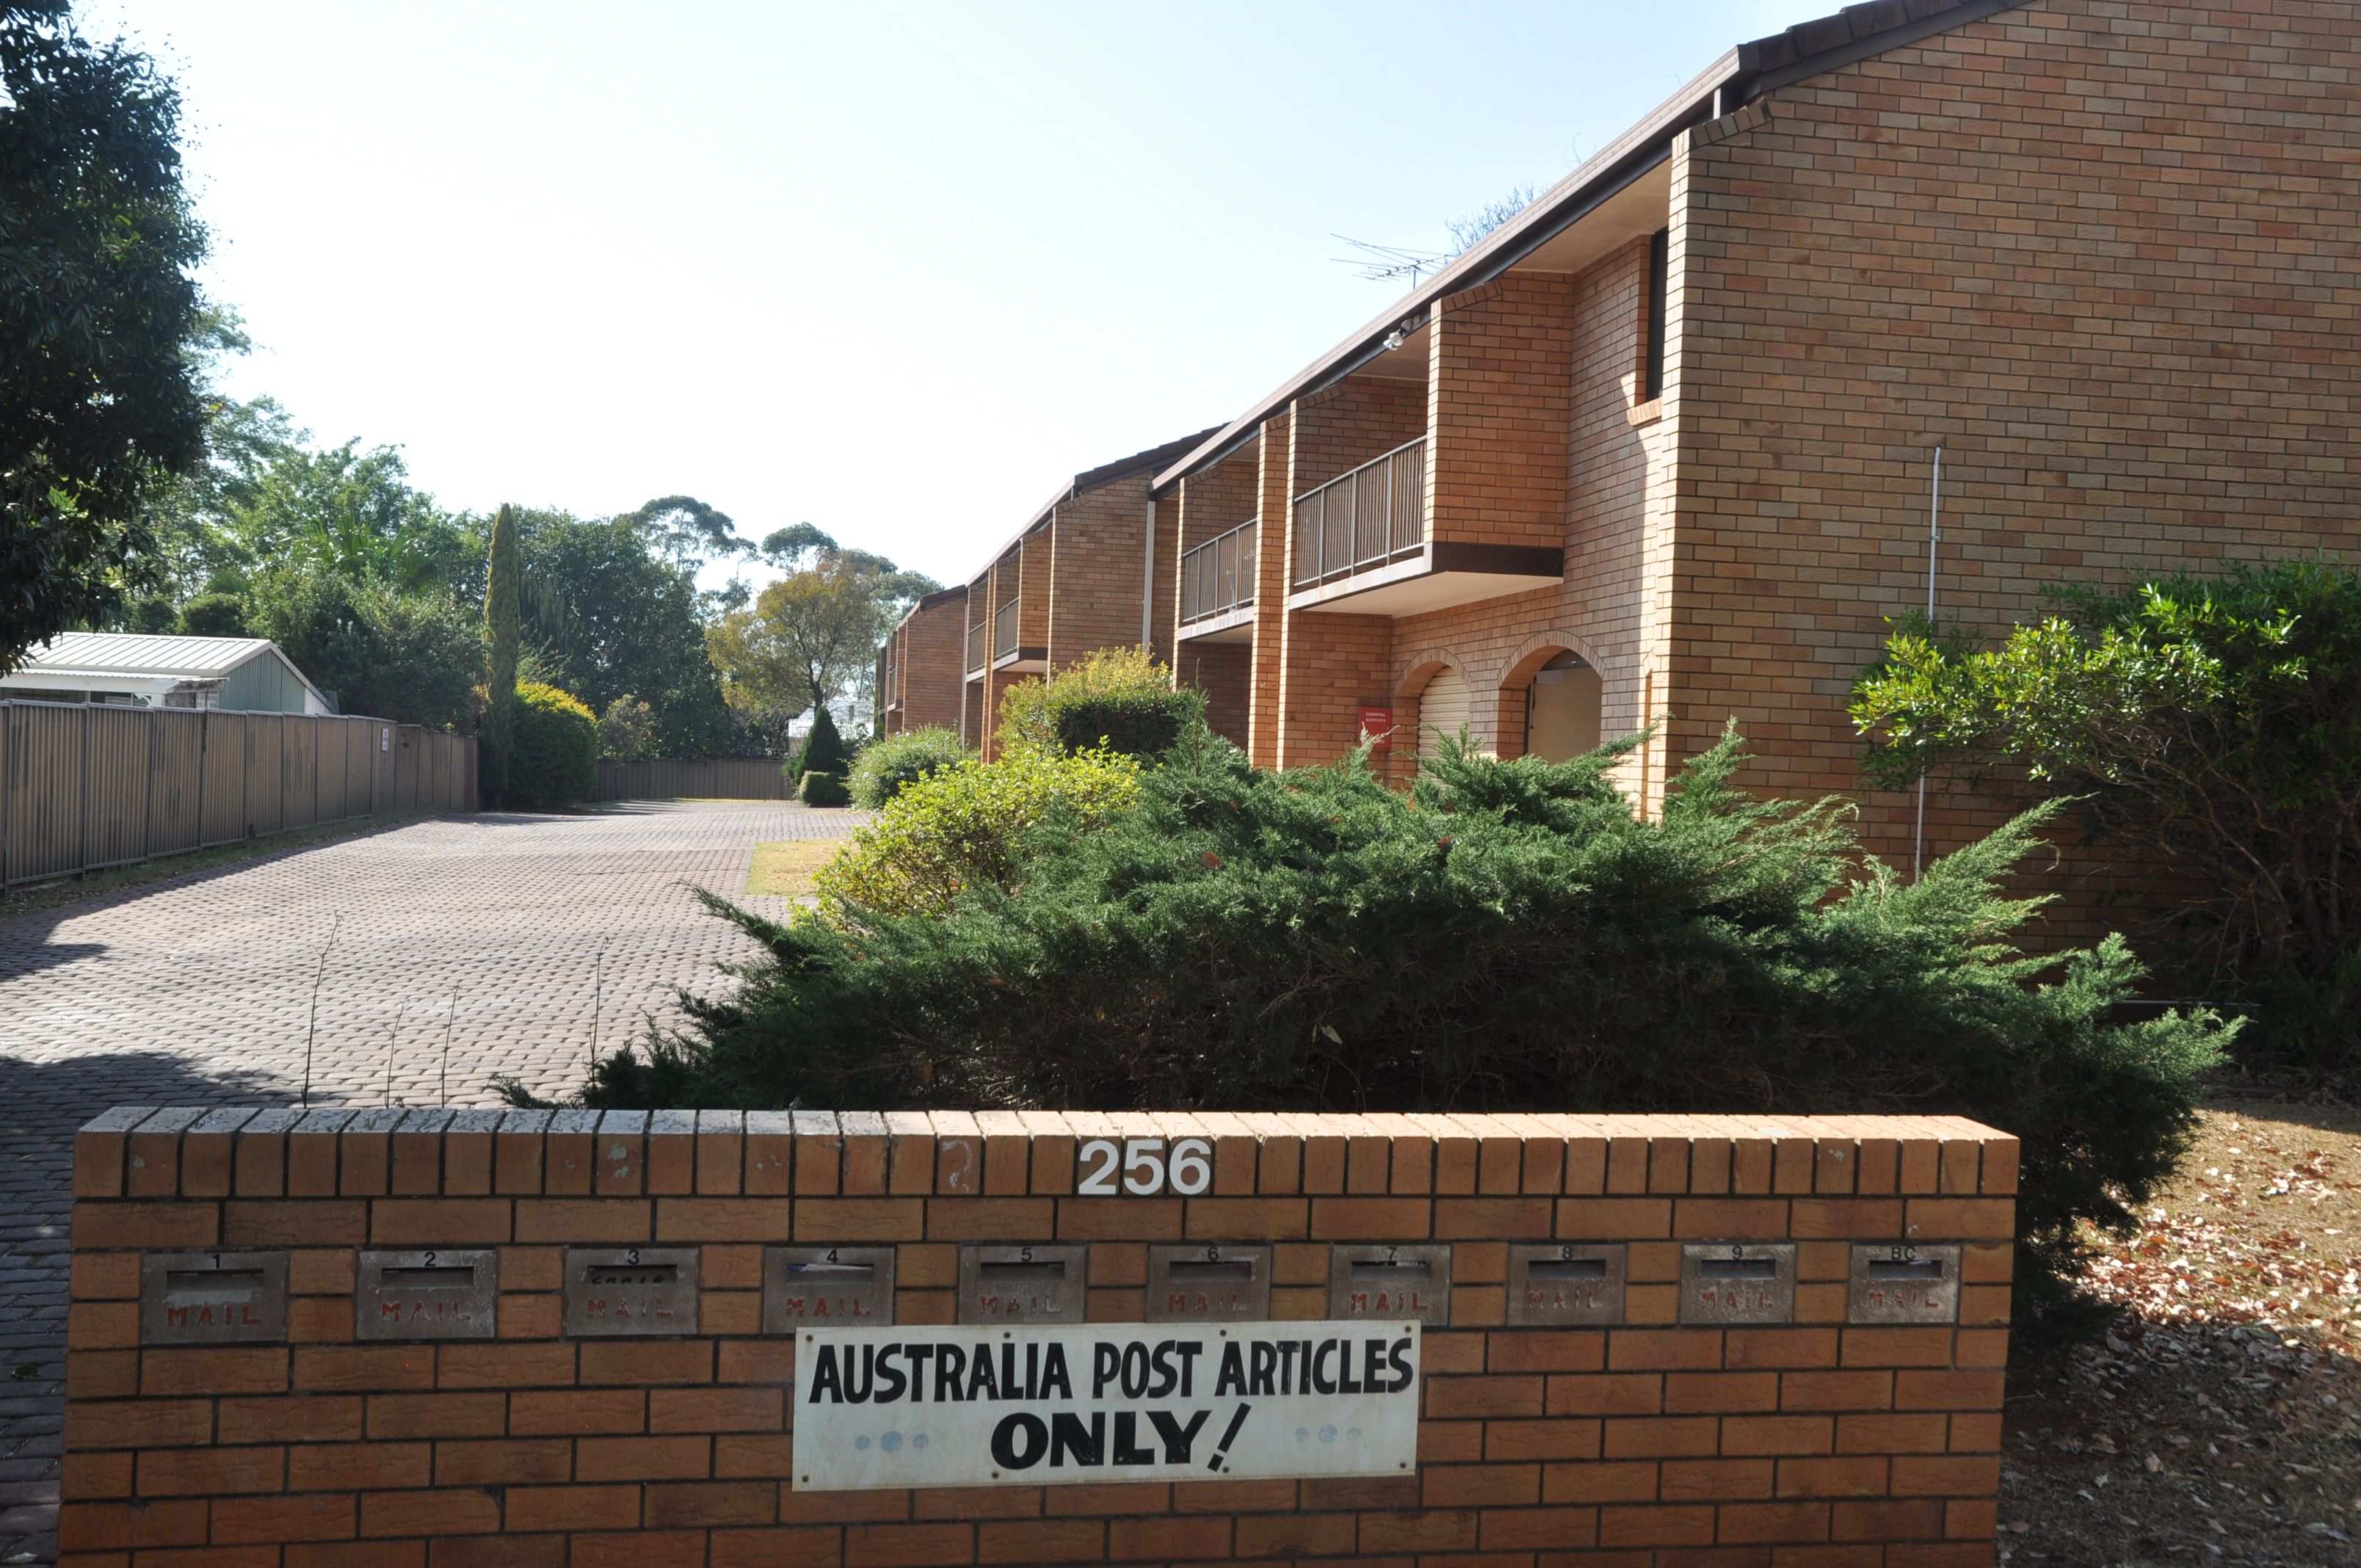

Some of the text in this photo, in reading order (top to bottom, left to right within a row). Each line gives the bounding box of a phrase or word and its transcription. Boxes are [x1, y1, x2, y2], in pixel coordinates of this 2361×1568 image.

[1078, 1138, 1211, 1195] 256
[212, 1254, 220, 1268] 1
[424, 1252, 437, 1267] 2
[628, 1249, 640, 1264] 3
[826, 1249, 838, 1263] 4
[1021, 1248, 1032, 1262] 5
[1207, 1247, 1219, 1262] 6
[1388, 1246, 1397, 1261] 7
[1562, 1245, 1573, 1260] 8
[1731, 1246, 1743, 1260] 9
[1891, 1246, 1917, 1260] BC
[588, 1297, 673, 1318] MAIL
[786, 1297, 871, 1317] MAIL
[981, 1294, 1062, 1314] MAIL
[1168, 1293, 1247, 1313] MAIL
[1350, 1292, 1428, 1313] MAIL
[1528, 1290, 1604, 1310] MAIL
[1700, 1290, 1773, 1310] MAIL
[1868, 1290, 1939, 1309] MAIL
[167, 1305, 261, 1326] MAIL
[381, 1300, 471, 1322] MAIL
[808, 1337, 1412, 1405] AUSTRALIA POST ARTICLES
[990, 1402, 1252, 1473] ONLY!
